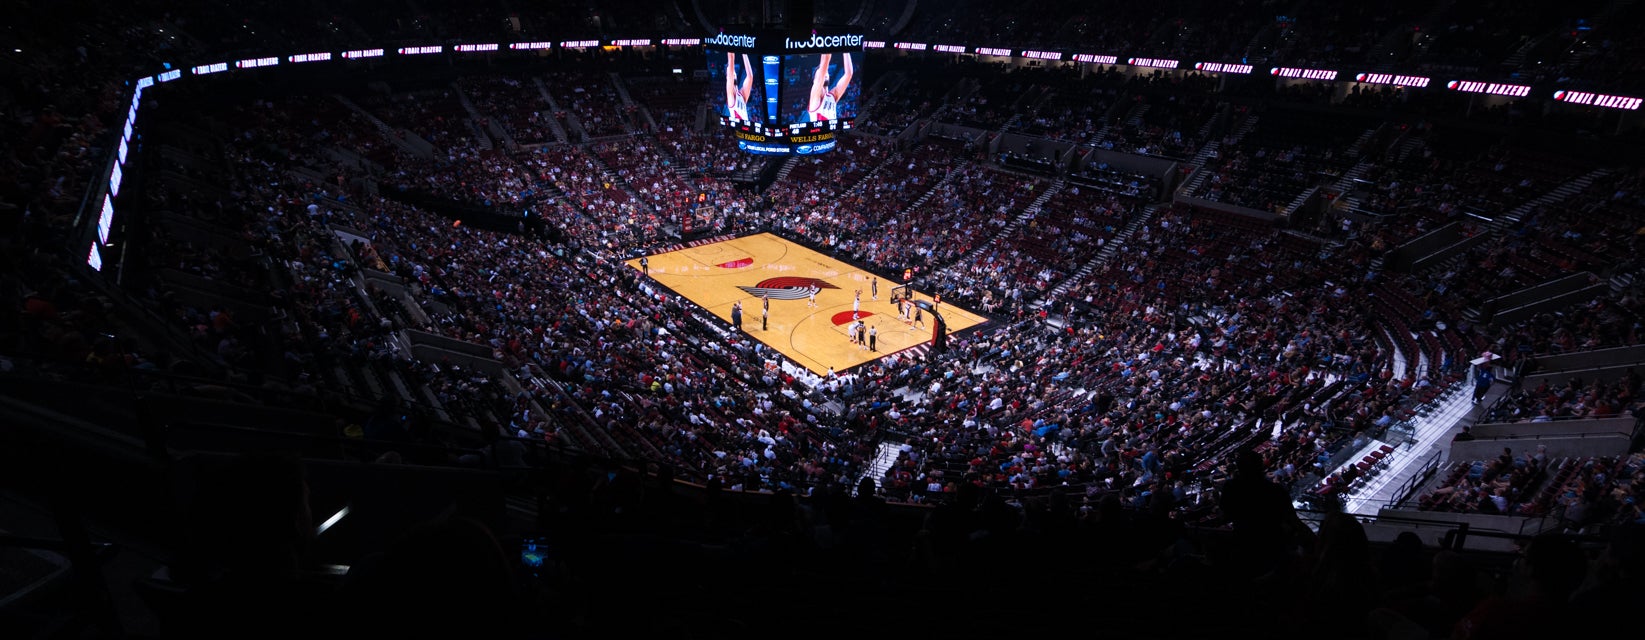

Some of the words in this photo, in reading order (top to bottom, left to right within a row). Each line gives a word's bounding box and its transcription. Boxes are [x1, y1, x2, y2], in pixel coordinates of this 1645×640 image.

[786, 34, 863, 48] modacenter
[1202, 62, 1222, 72] TRAIL
[1222, 64, 1253, 74] BLAZERS
[1279, 67, 1302, 78] TRAIL
[1302, 69, 1338, 80] BLAZERS
[1366, 73, 1391, 84] TRAIL
[1392, 75, 1430, 88] BLAZERS
[1457, 80, 1486, 93] TRAIL
[1486, 83, 1531, 96] BLAZERS
[1563, 91, 1596, 105] TRAIL
[1594, 94, 1643, 110] BLAZERS
